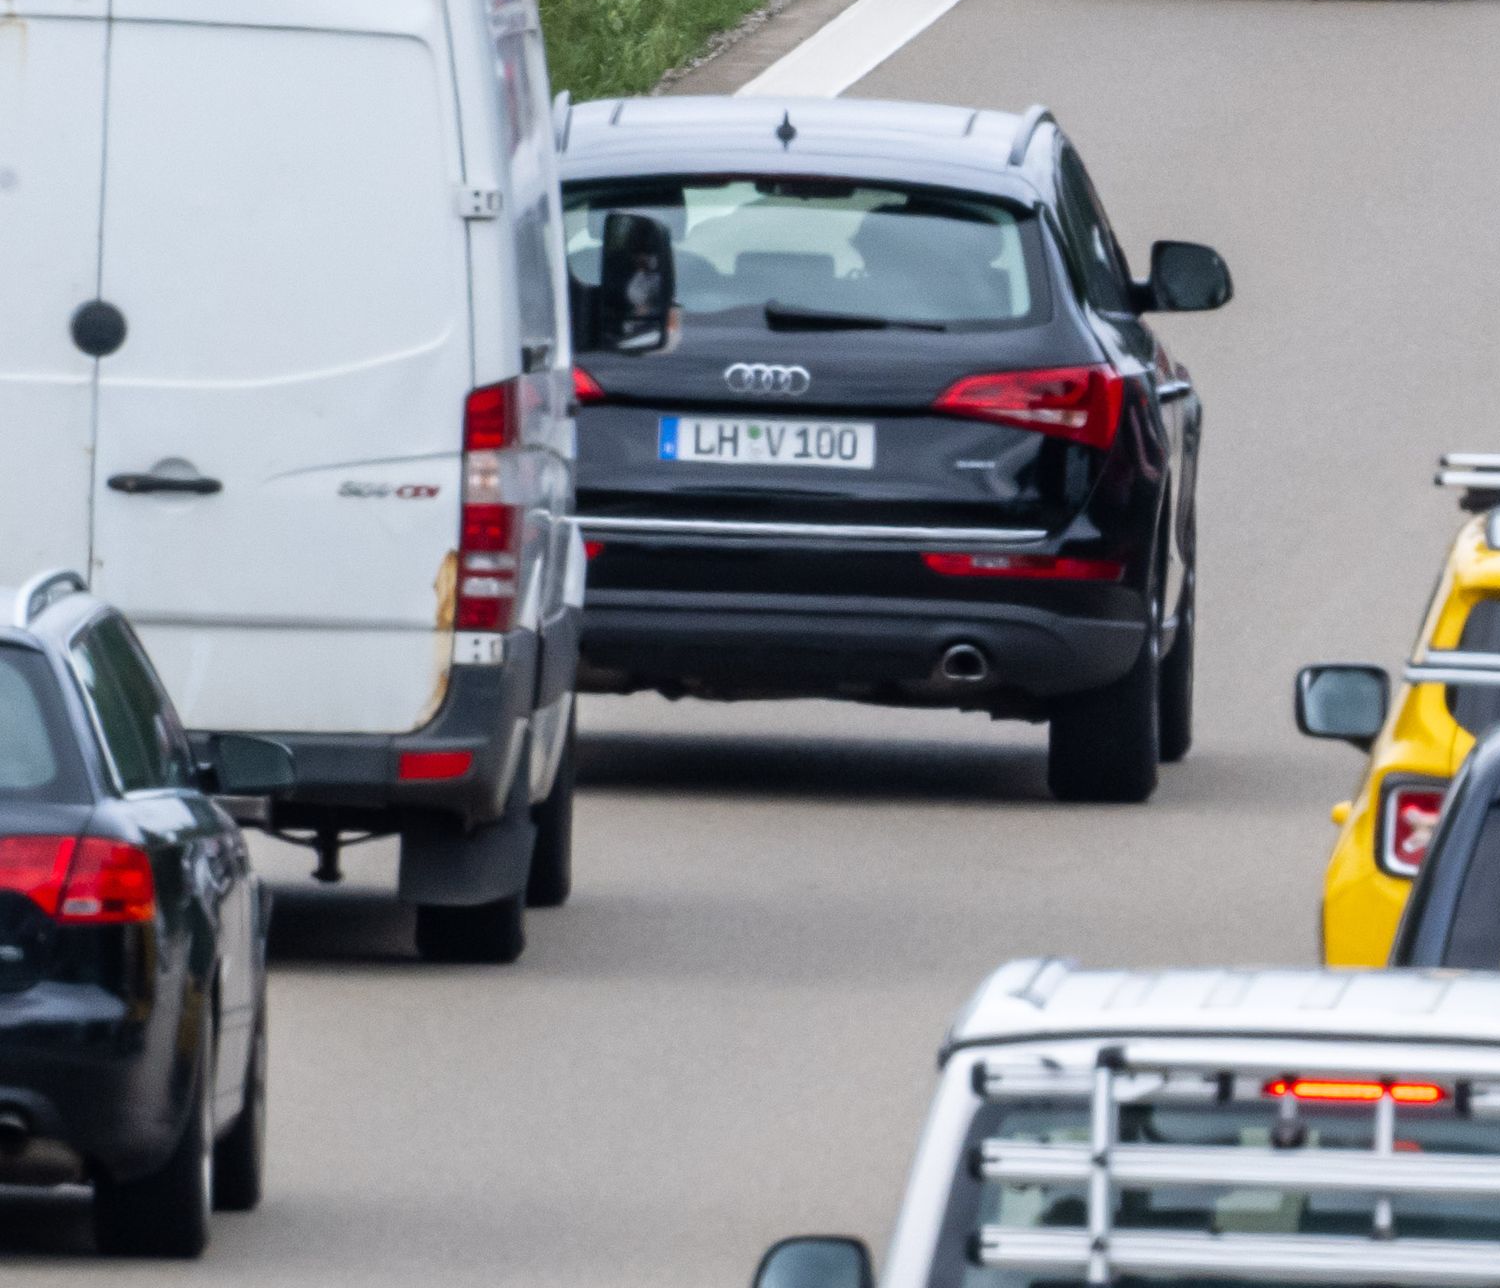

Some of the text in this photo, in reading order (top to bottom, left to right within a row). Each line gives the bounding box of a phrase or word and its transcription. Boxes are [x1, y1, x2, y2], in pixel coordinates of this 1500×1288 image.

[693, 423, 860, 461] LH V 100
